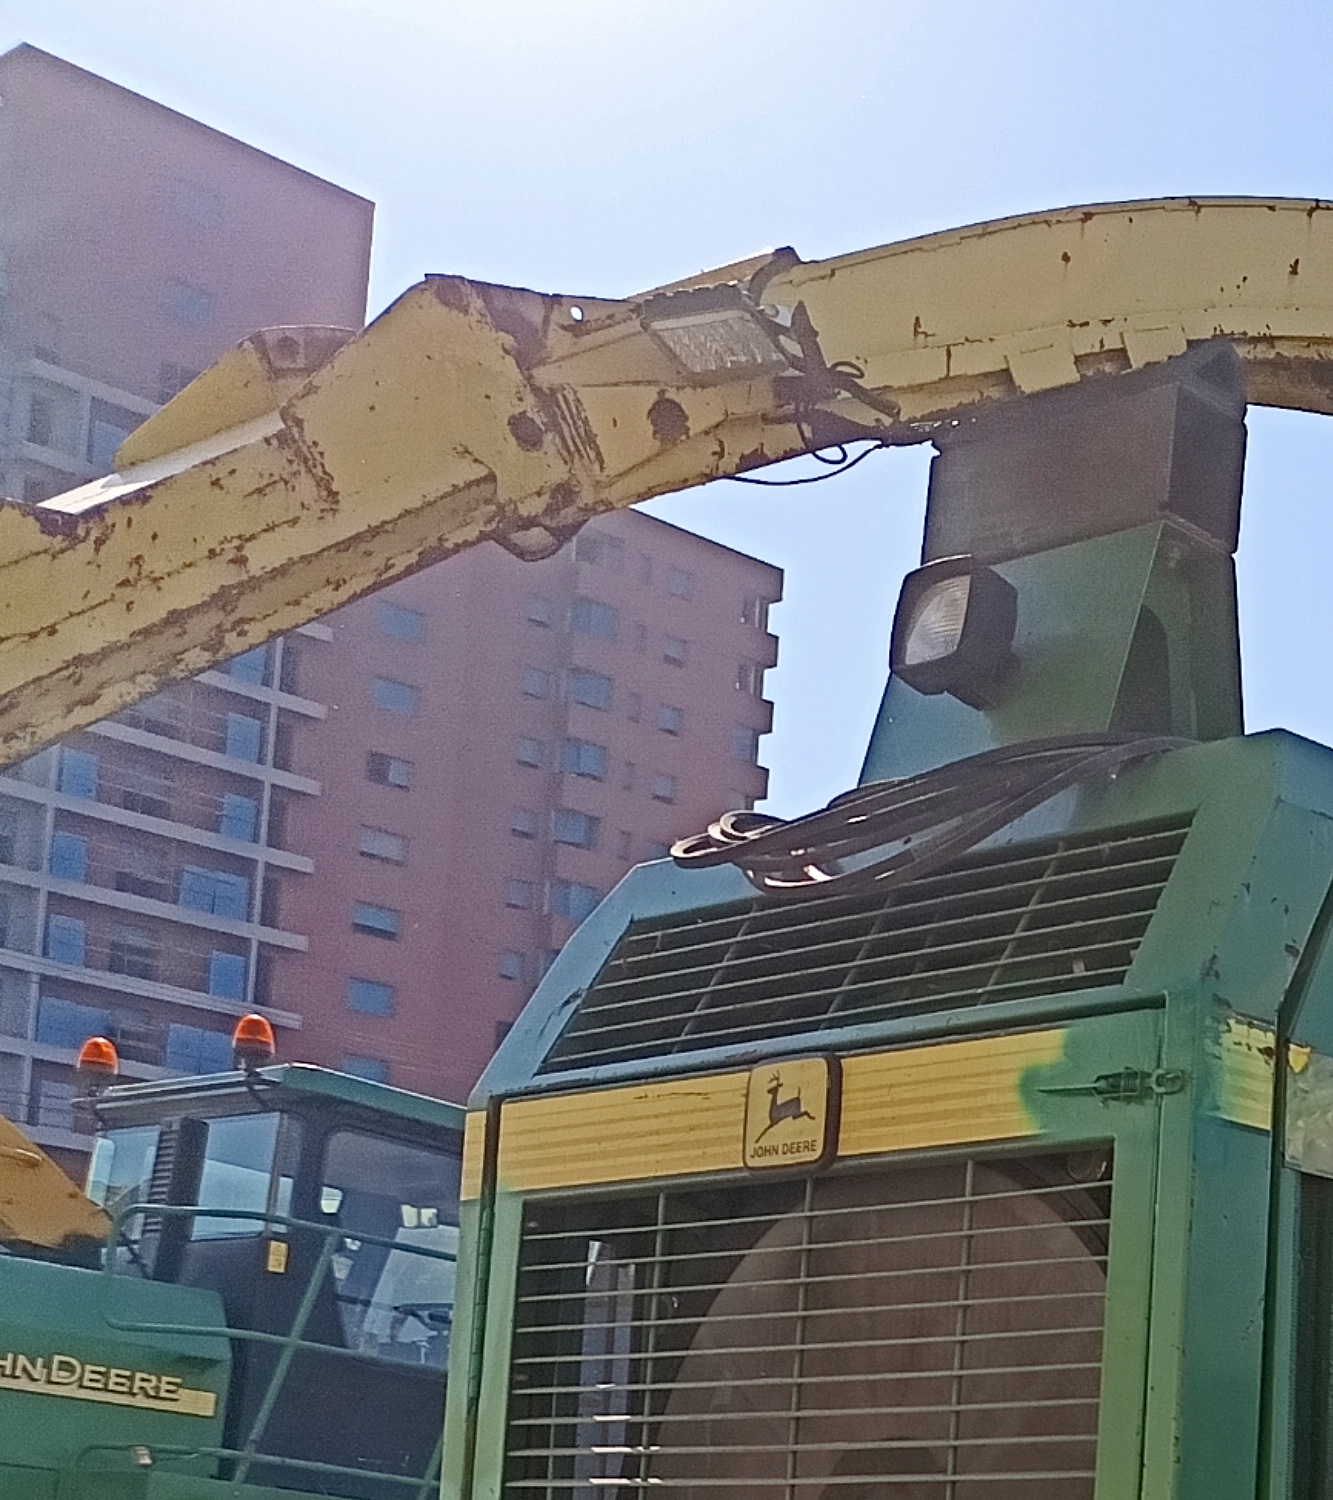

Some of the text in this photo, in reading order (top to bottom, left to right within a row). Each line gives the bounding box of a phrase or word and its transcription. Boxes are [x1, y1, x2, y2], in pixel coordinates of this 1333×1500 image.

[750, 1139, 817, 1158] JOHN DEERE
[50, 1354, 182, 1400] DEERE
